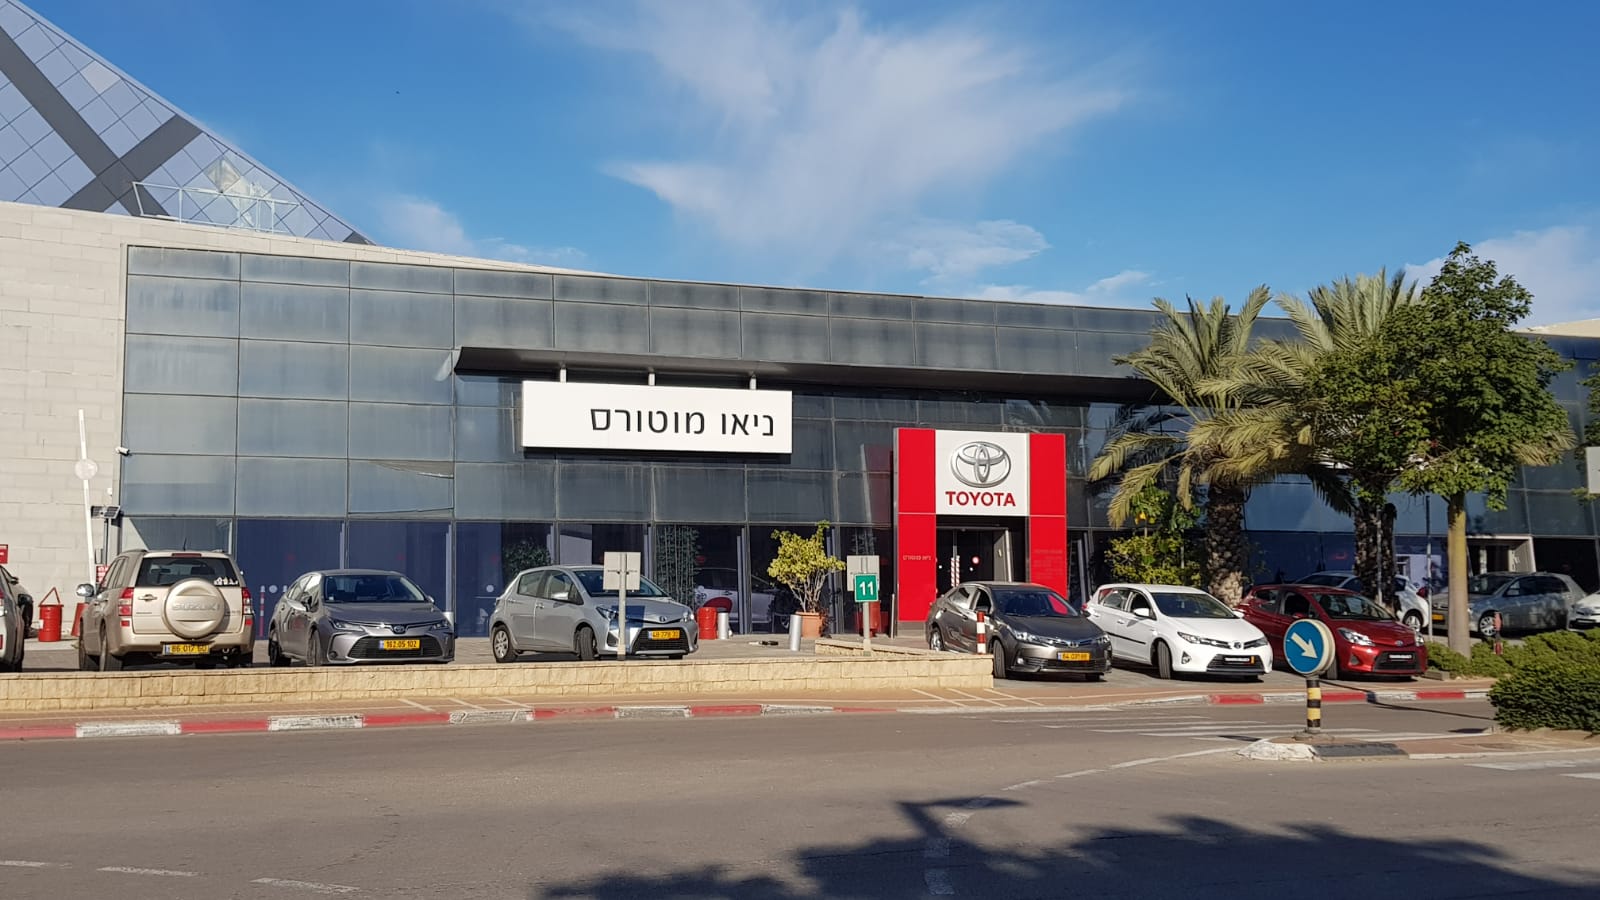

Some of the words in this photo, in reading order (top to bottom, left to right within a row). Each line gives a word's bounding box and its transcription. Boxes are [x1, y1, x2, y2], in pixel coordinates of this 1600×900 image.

[590, 408, 705, 434] מוטורס
[722, 413, 774, 437] ניאו
[945, 491, 1016, 507] TOYOTA
[859, 581, 874, 596] 11
[172, 601, 220, 611] SUZUKI
